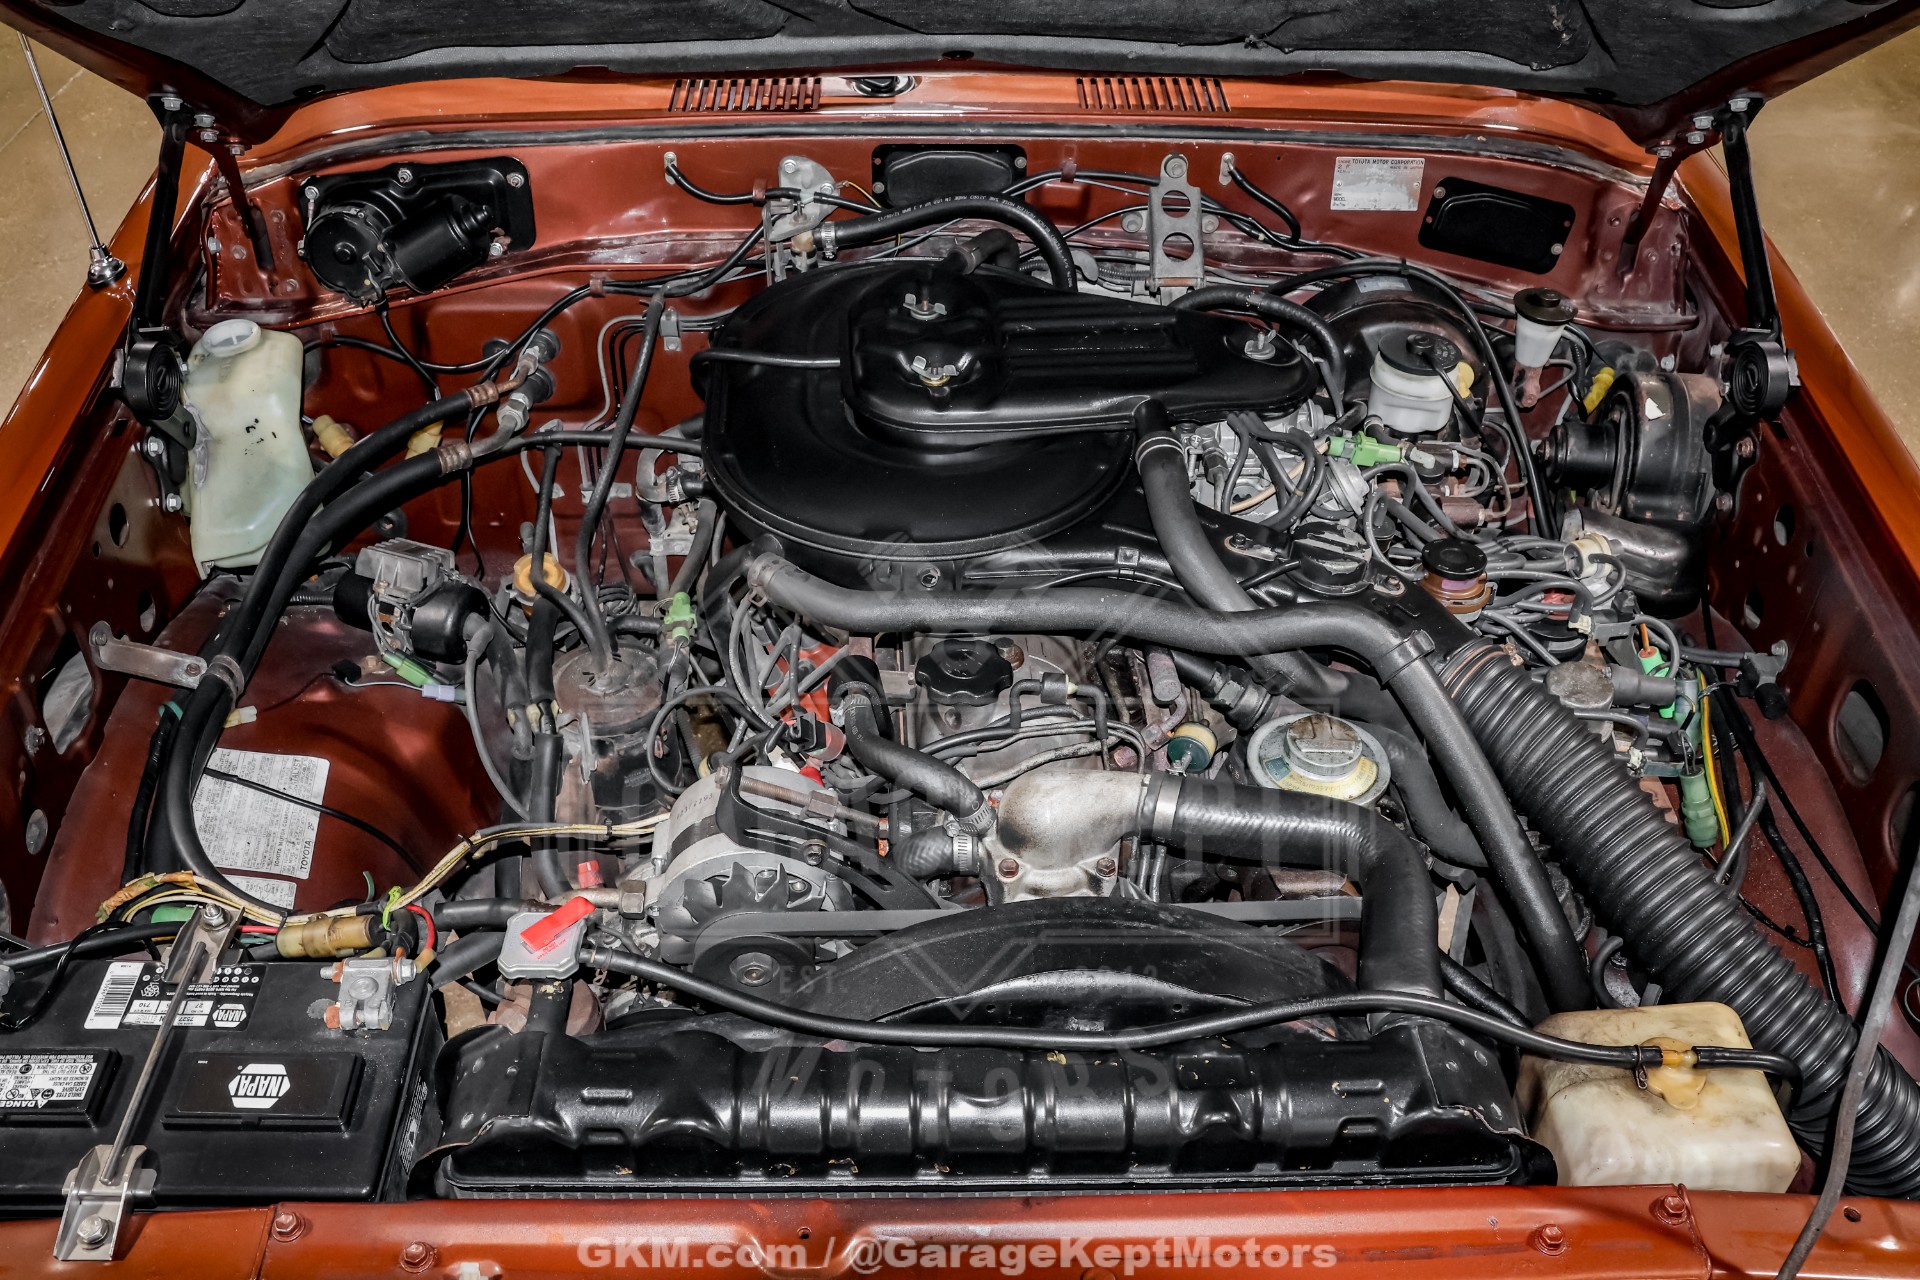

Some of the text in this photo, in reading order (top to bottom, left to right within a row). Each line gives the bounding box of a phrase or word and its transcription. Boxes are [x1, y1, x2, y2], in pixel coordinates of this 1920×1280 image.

[300, 840, 312, 870] TOYOTA
[219, 1010, 241, 1021] NAPA
[237, 1075, 283, 1096] NAPA
